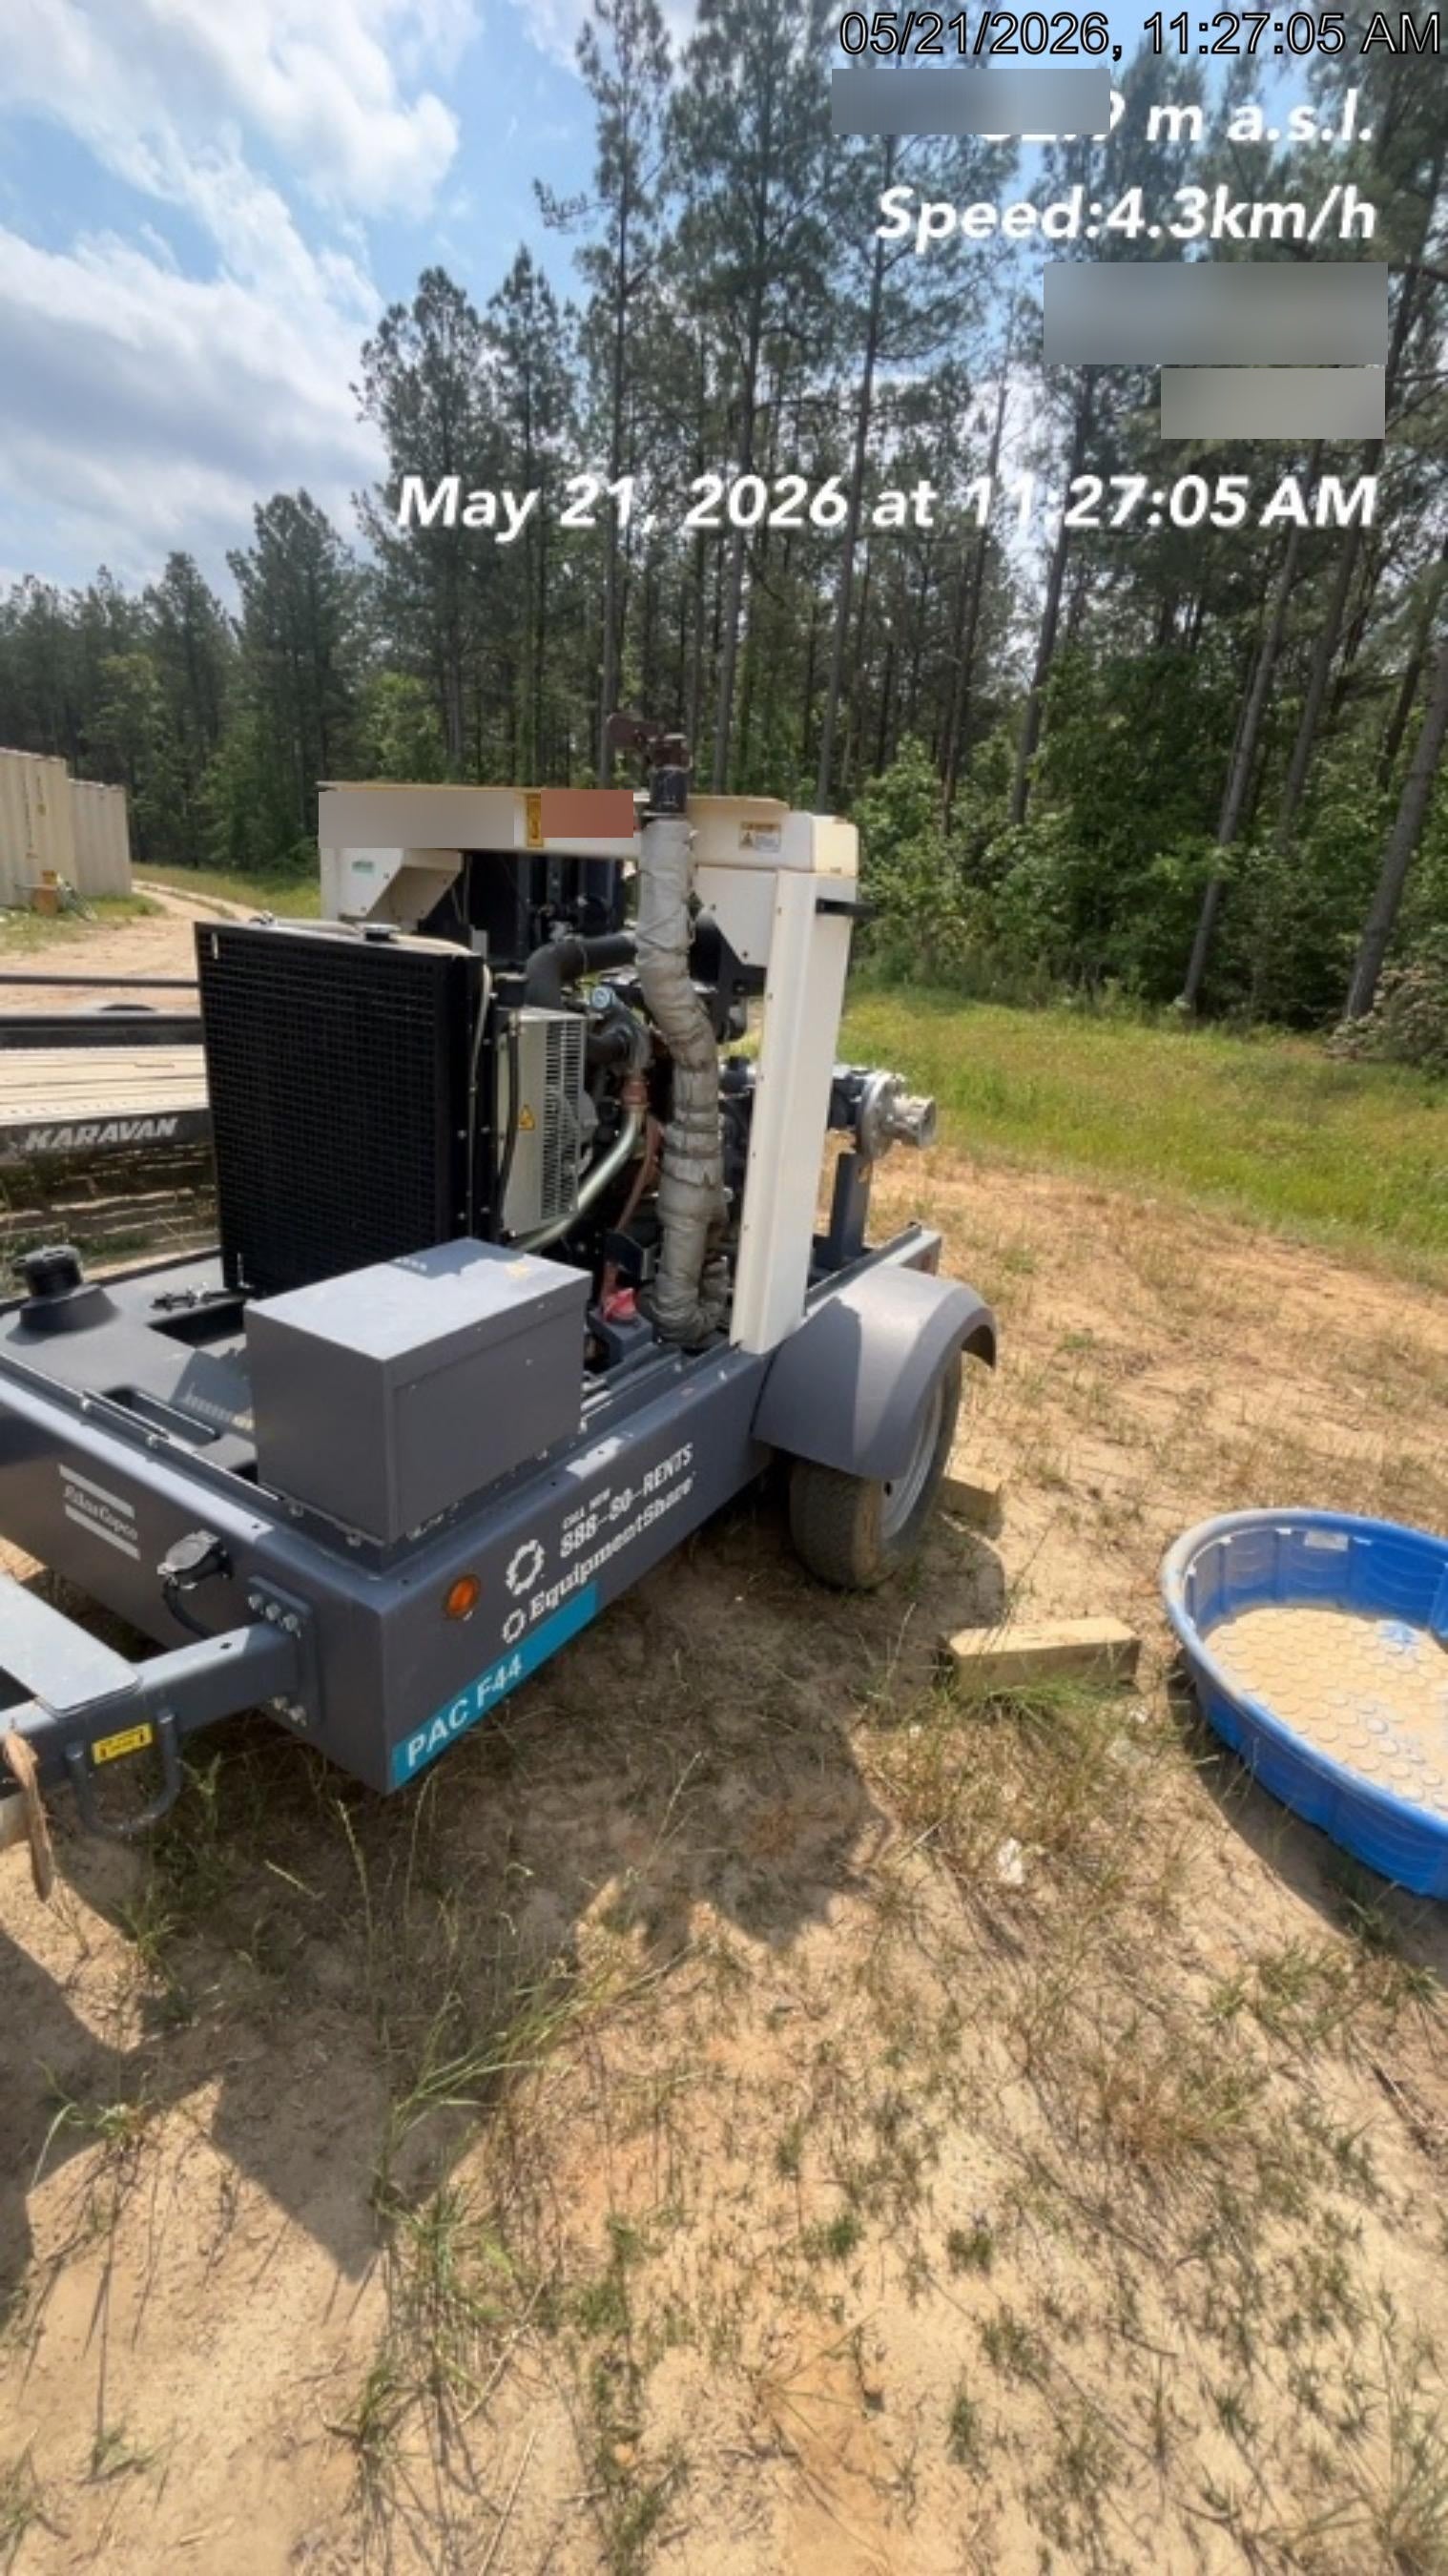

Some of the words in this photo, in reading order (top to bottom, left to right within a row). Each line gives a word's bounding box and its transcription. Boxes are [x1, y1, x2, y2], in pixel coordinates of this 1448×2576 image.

[25, 1116, 178, 1153] KARAVAN
[528, 1476, 693, 1622] EquipmentShare
[406, 1699, 471, 1768] PAC
[475, 1653, 524, 1711] F44
